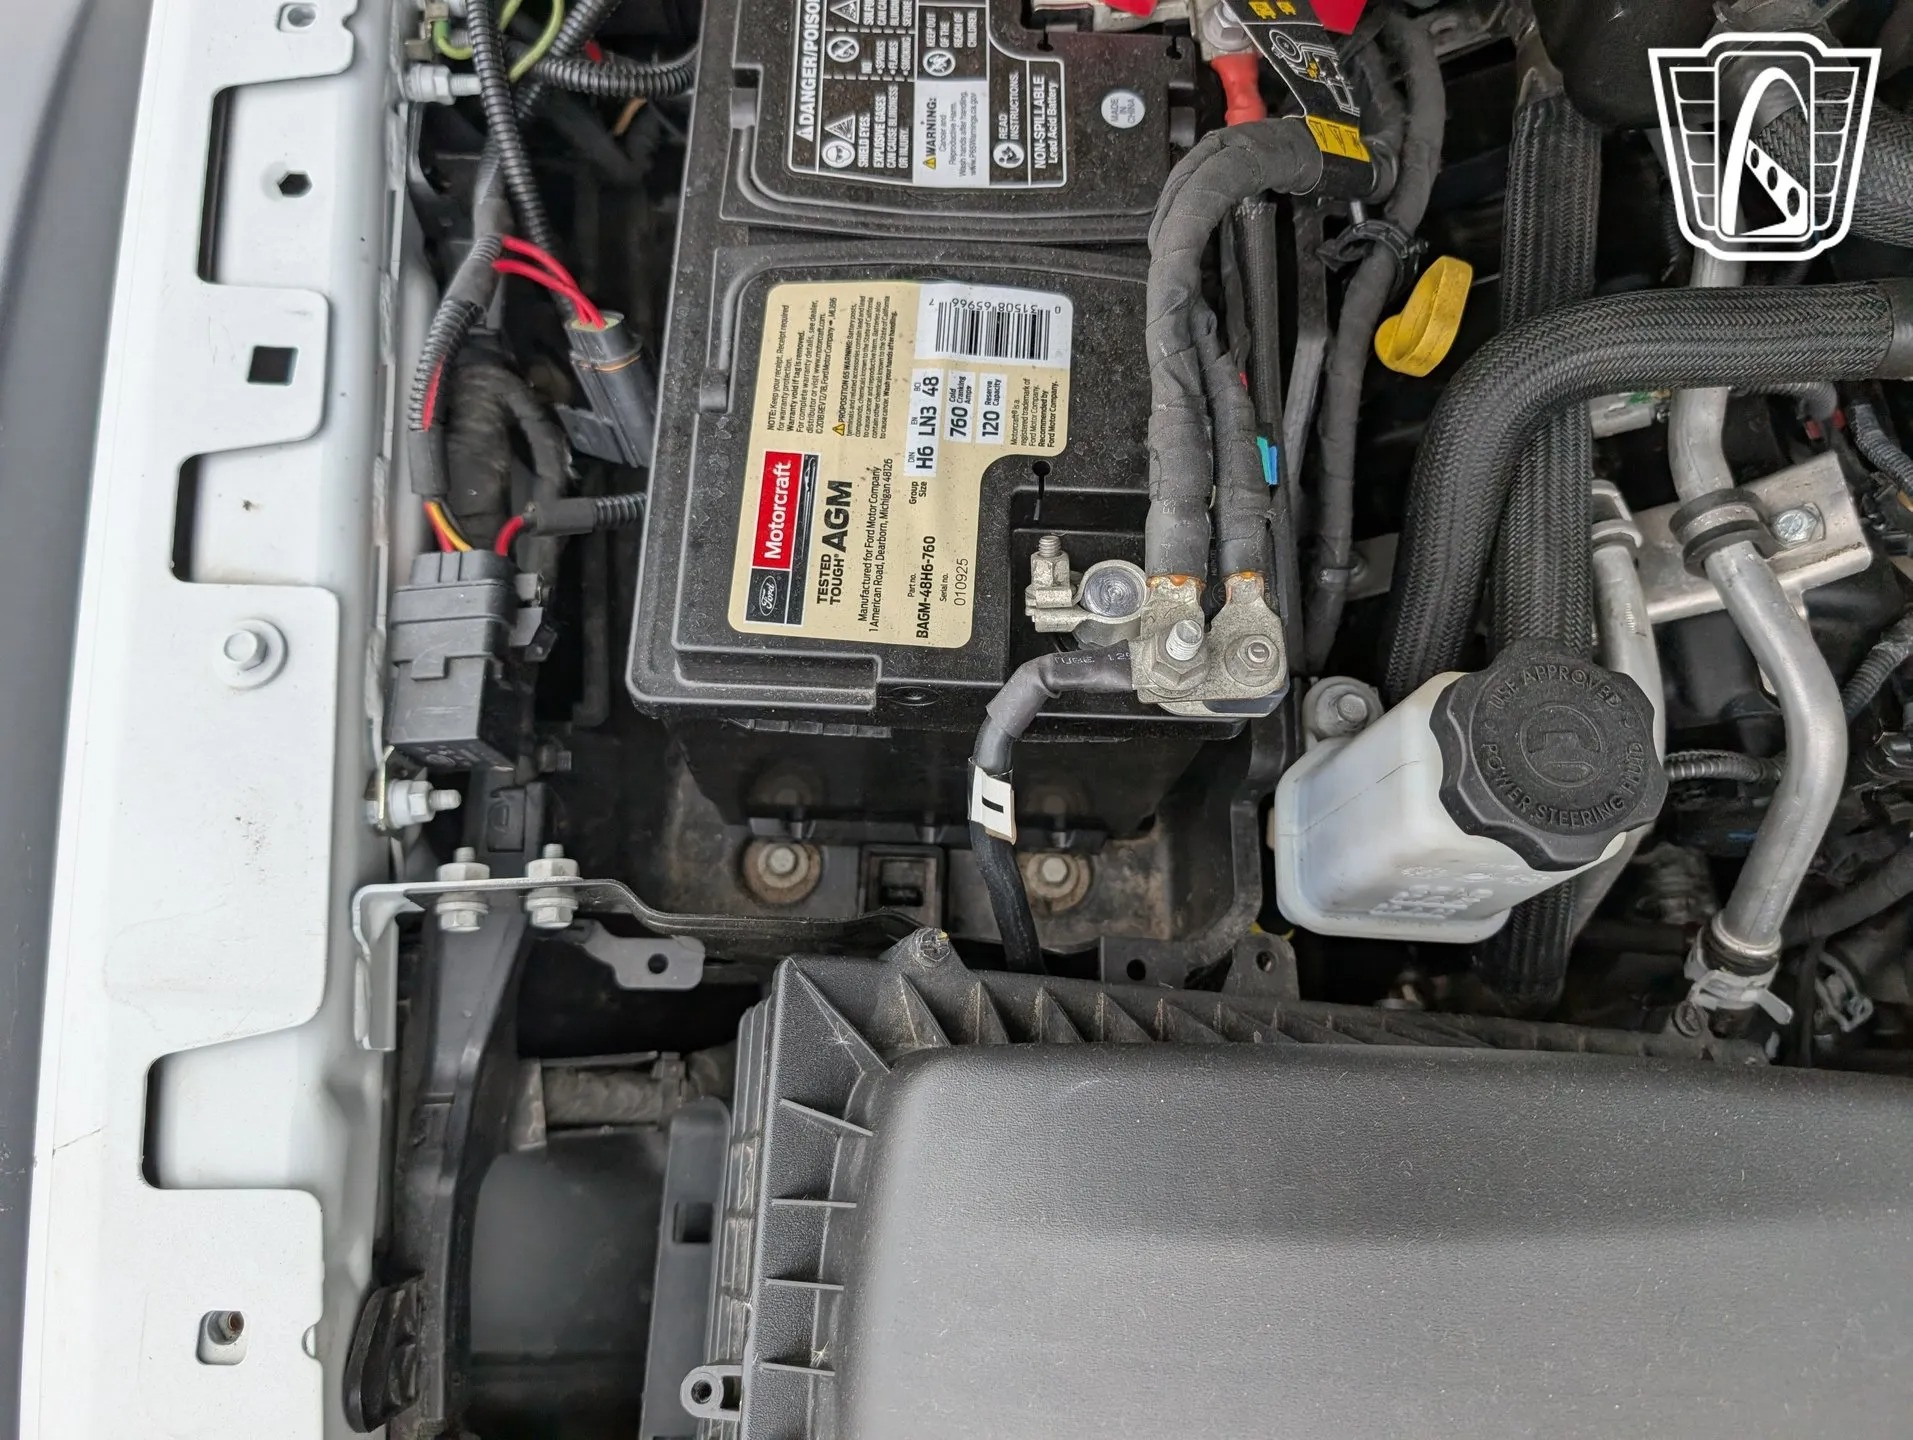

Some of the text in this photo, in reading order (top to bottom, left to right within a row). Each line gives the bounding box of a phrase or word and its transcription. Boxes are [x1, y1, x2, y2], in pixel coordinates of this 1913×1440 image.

[925, 13, 935, 47] KEEP OUT
[939, 21, 949, 47] OF THE
[953, 12, 963, 47] REACH OF
[799, 0, 820, 125] DANGER/POISO
[901, 36, 911, 70] SMOKING
[1008, 70, 1020, 139] INSTRUCTIONS.
[1110, 98, 1119, 122] MADE
[1120, 106, 1126, 115] IN
[1128, 98, 1136, 124] CHINA
[873, 95, 885, 167] EXPLOSIVE GASES
[886, 85, 898, 168] CAN CAUSE BLINDNESS
[925, 97, 937, 156] WARNING:
[939, 114, 947, 126] and
[959, 121, 967, 135] after
[998, 114, 1007, 139] READ
[1031, 75, 1047, 168] NON-SPILLABLE
[1046, 81, 1058, 162] Lead Acid Battery
[857, 112, 870, 167] SHIELD EYES.
[898, 127, 909, 168] OR INJURY.
[949, 123, 958, 164] Reproductive
[958, 137, 966, 156] hands
[958, 158, 966, 176] Wash
[779, 304, 789, 330] required
[951, 298, 991, 310] 65966
[997, 302, 1037, 313] 31508
[776, 331, 786, 353] Receipt
[794, 330, 805, 360] removed.
[824, 326, 835, 353] Company
[822, 353, 831, 370] Motor
[843, 339, 853, 370] WARNING:
[883, 381, 891, 396] Wash
[887, 336, 895, 350] after
[771, 378, 781, 392] your
[792, 367, 802, 378] tag
[801, 359, 812, 388] warranty
[810, 375, 819, 388] visit
[820, 371, 829, 384] Ford
[842, 371, 850, 379] 65
[769, 392, 779, 408] Keep
[776, 357, 793, 430] for warranty protection.
[790, 385, 798, 399] void
[837, 379, 849, 422] PROPOSITION
[948, 388, 956, 402] Cold
[956, 376, 966, 403] Cranking
[964, 385, 972, 404] Amps
[984, 380, 992, 405] Reserve
[993, 379, 1001, 405] Capacity
[786, 400, 797, 431] Warranty
[797, 389, 808, 420] complete
[805, 397, 816, 433] distributor
[1019, 377, 1030, 445] registered trademark of
[1028, 384, 1039, 446] Ford Motor Company.
[1038, 389, 1048, 446] Recommended by
[1047, 380, 1058, 447] Ford Motor Company.
[767, 409, 776, 430] NOTE:
[796, 421, 804, 432] For
[911, 416, 917, 424] EN
[915, 376, 939, 469] H6 LN3 48
[949, 406, 967, 437] 760
[982, 410, 999, 437] 120
[882, 458, 892, 481] 48126
[907, 451, 915, 462] DIN
[879, 483, 892, 519] Michigan
[908, 481, 918, 504] Group
[918, 481, 927, 497] Size
[762, 461, 791, 559] Motorcraft
[820, 480, 852, 552] AGM
[857, 466, 882, 621] Manufactured for Ford Motor Company
[875, 520, 888, 559] Dearborn,
[816, 553, 832, 604] TESTED
[873, 561, 884, 585] Road,
[915, 535, 936, 638] BAGM-48H6-760
[953, 557, 968, 606] 010925
[760, 582, 775, 609] Ford
[907, 583, 915, 597] Part
[939, 584, 947, 601] Serial
[869, 586, 881, 627] American
[1490, 663, 1622, 710] USE APPROVED
[1480, 741, 1644, 827] POWER STEERING FLUID
